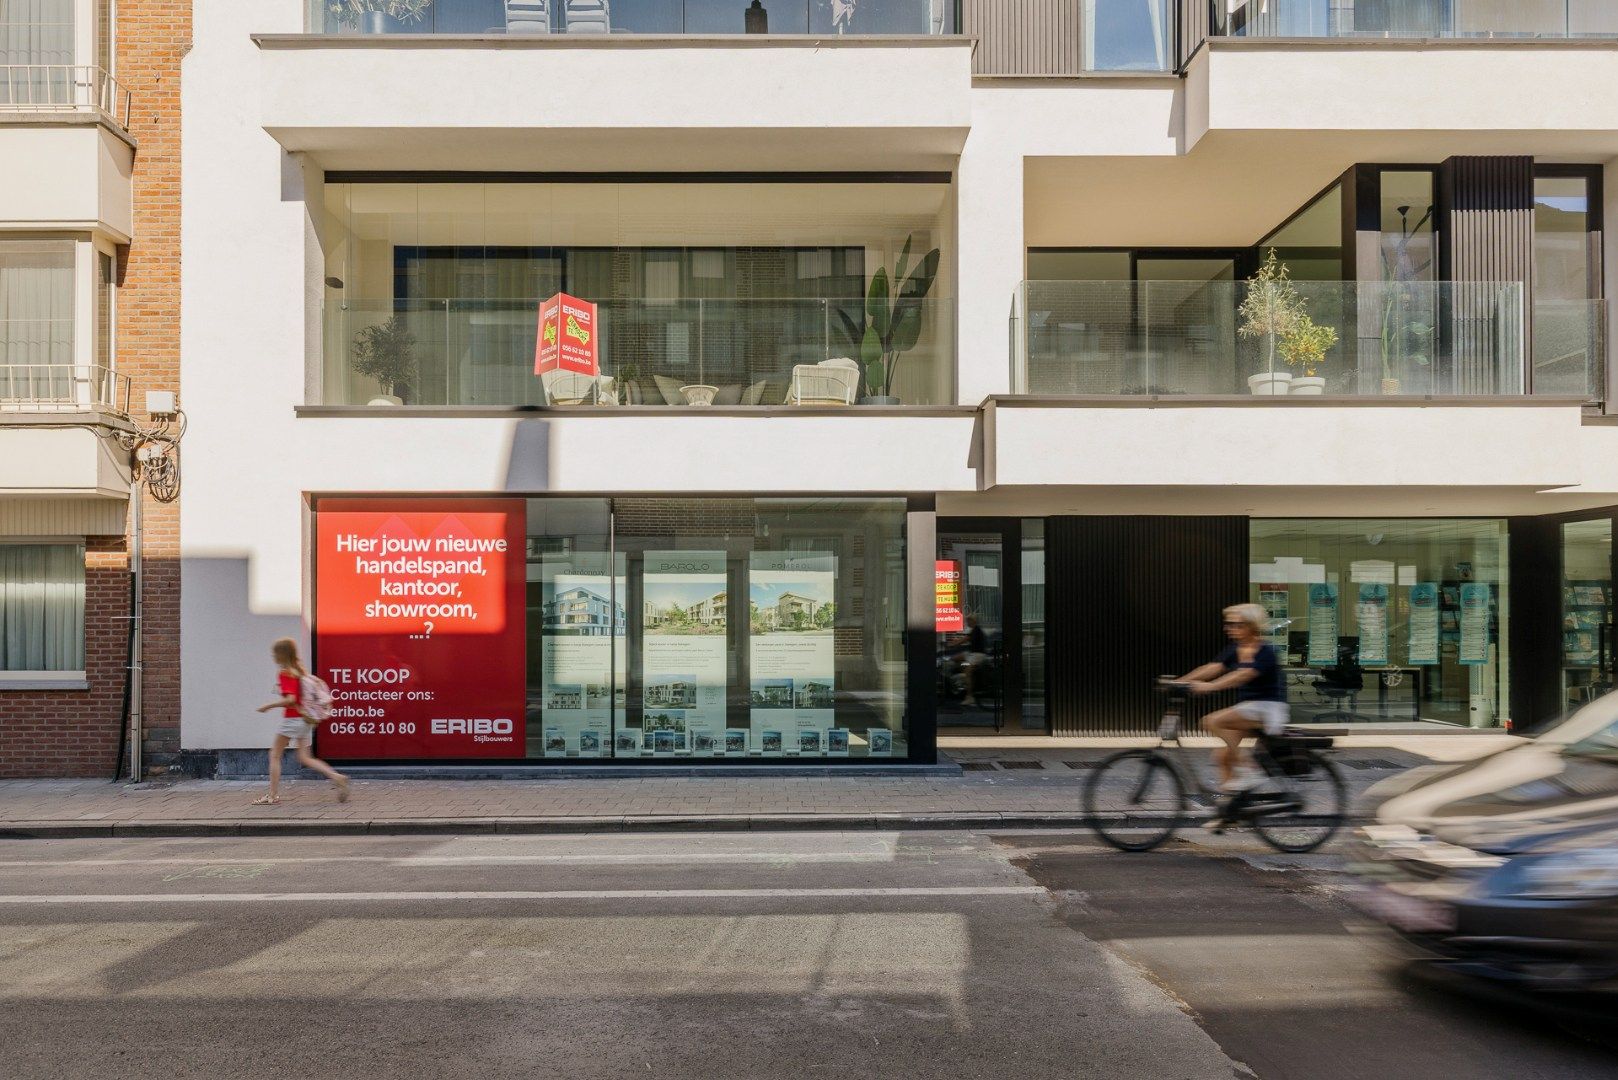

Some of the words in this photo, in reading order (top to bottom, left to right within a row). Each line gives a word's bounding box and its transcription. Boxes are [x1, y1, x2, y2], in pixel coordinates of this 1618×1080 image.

[562, 305, 590, 320] ERIBO
[336, 534, 378, 552] Hier
[380, 534, 432, 556] jouw
[435, 534, 508, 553] nieuwe
[356, 556, 487, 578] handelspand,
[563, 568, 607, 576] Chardonnay
[660, 563, 710, 571] BAROLO
[381, 578, 463, 598] kantoor,
[365, 600, 478, 620] showroom,
[330, 668, 352, 684] TE
[357, 668, 411, 684] KOOP
[330, 688, 403, 701] Contacteer
[407, 690, 435, 701] ons:
[330, 706, 385, 718] eribo.be
[330, 722, 356, 734] 056
[359, 722, 376, 734] 62
[379, 722, 395, 734] 10
[398, 722, 416, 734] 80
[431, 718, 513, 734] ERIBO
[473, 735, 513, 744] Stijlbouwers
